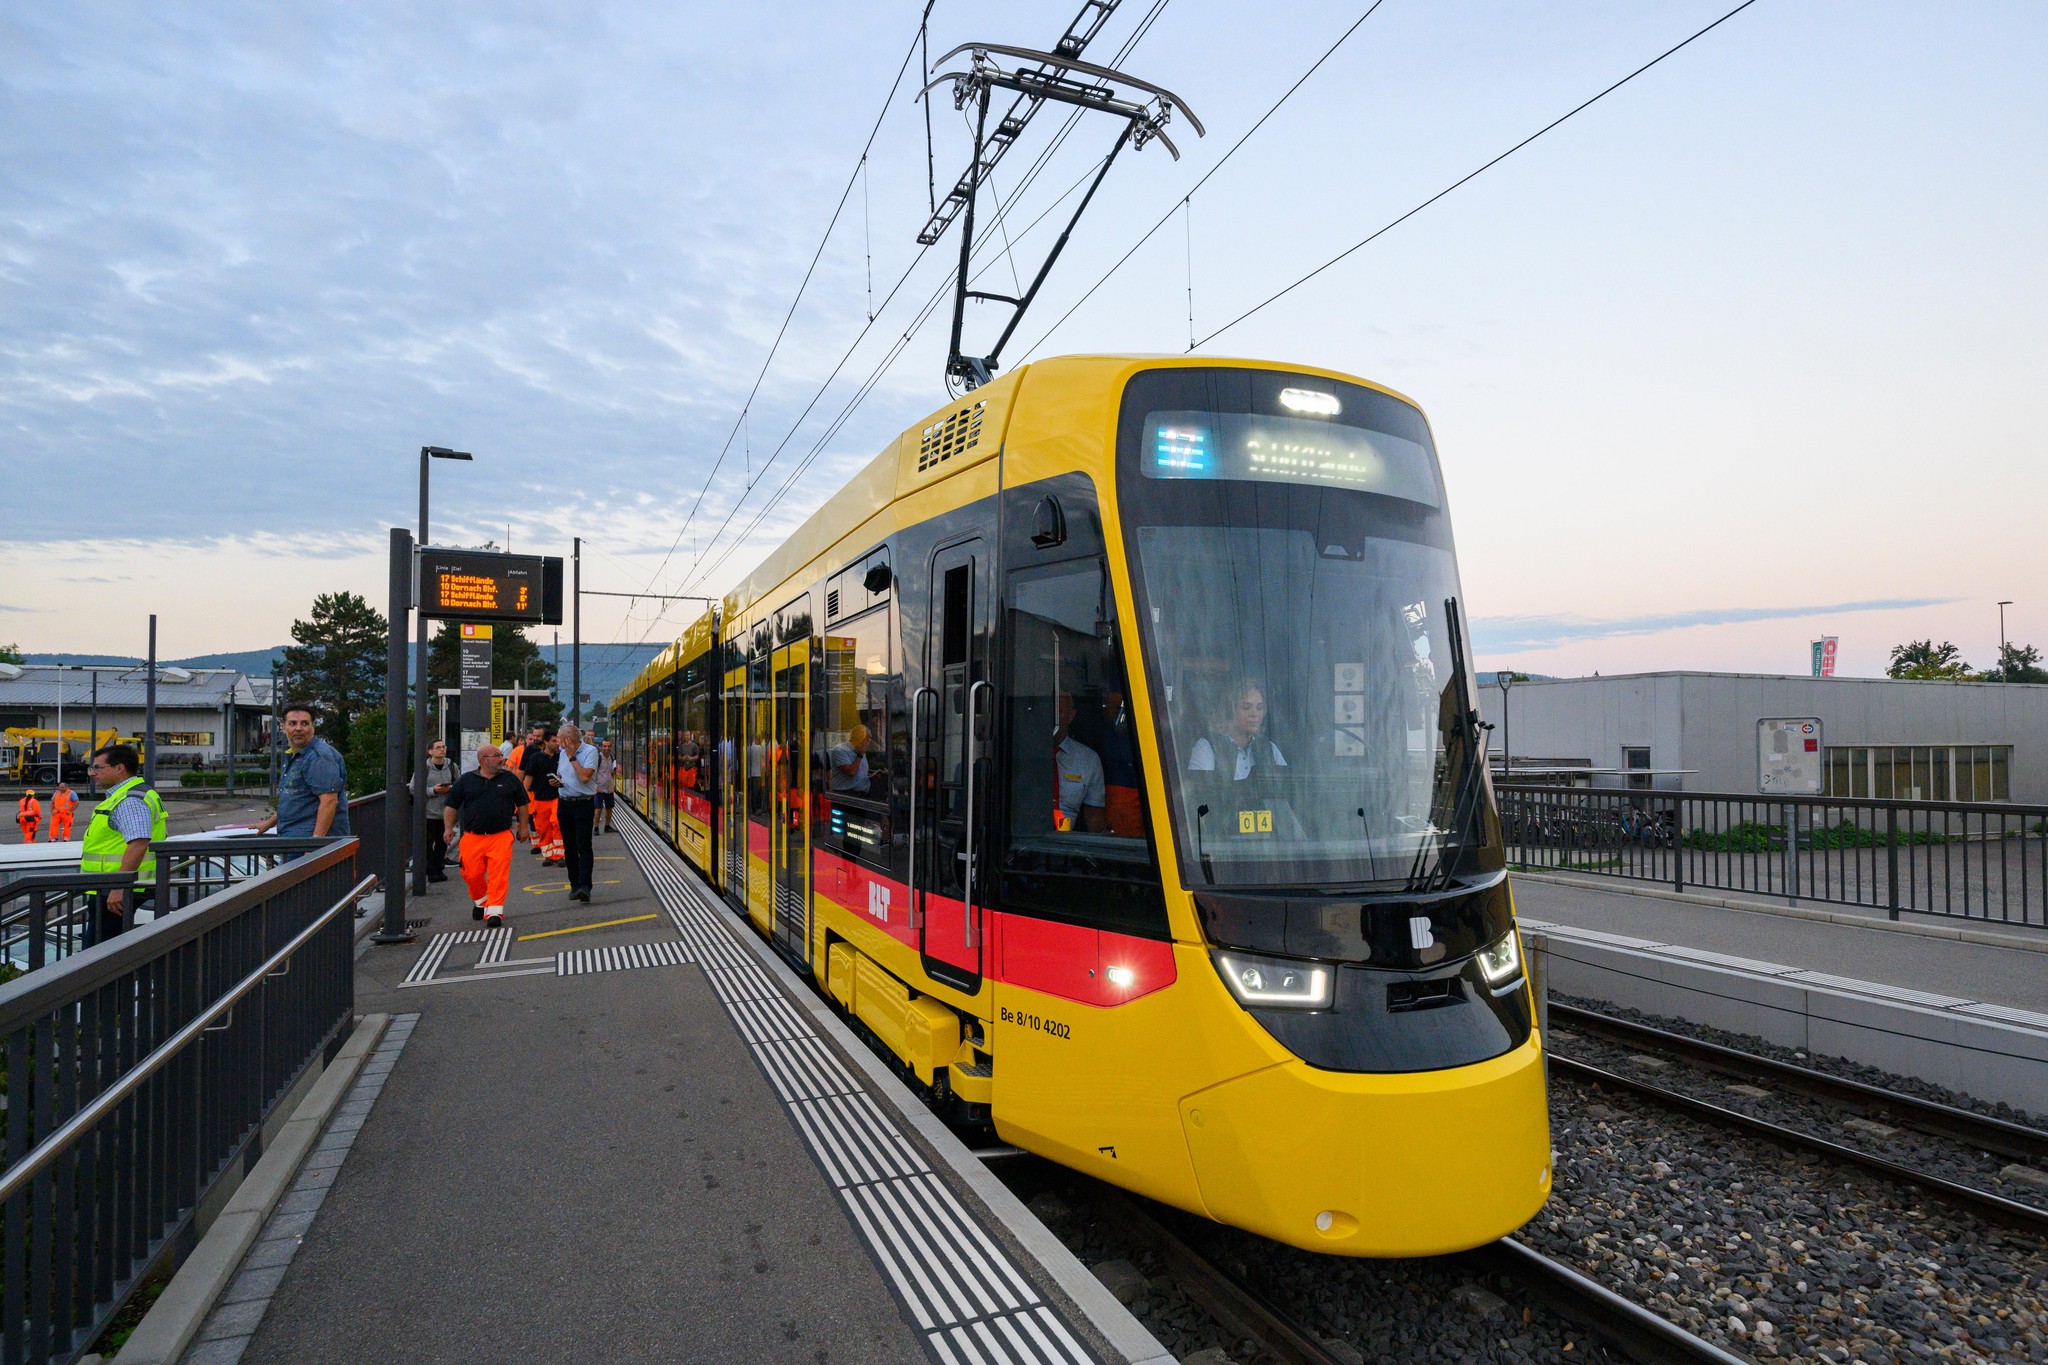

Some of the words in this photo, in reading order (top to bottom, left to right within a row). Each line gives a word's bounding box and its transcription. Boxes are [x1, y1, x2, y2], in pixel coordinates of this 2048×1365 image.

[450, 575, 494, 584] Schifflände
[450, 584, 482, 592] Dornach
[450, 592, 494, 600] Schifflände
[450, 600, 481, 608] Dornach
[869, 880, 890, 922] BLT
[1001, 1007, 1013, 1023] Be
[1017, 1011, 1040, 1030] 8/10
[1043, 1019, 1070, 1040] 4202
